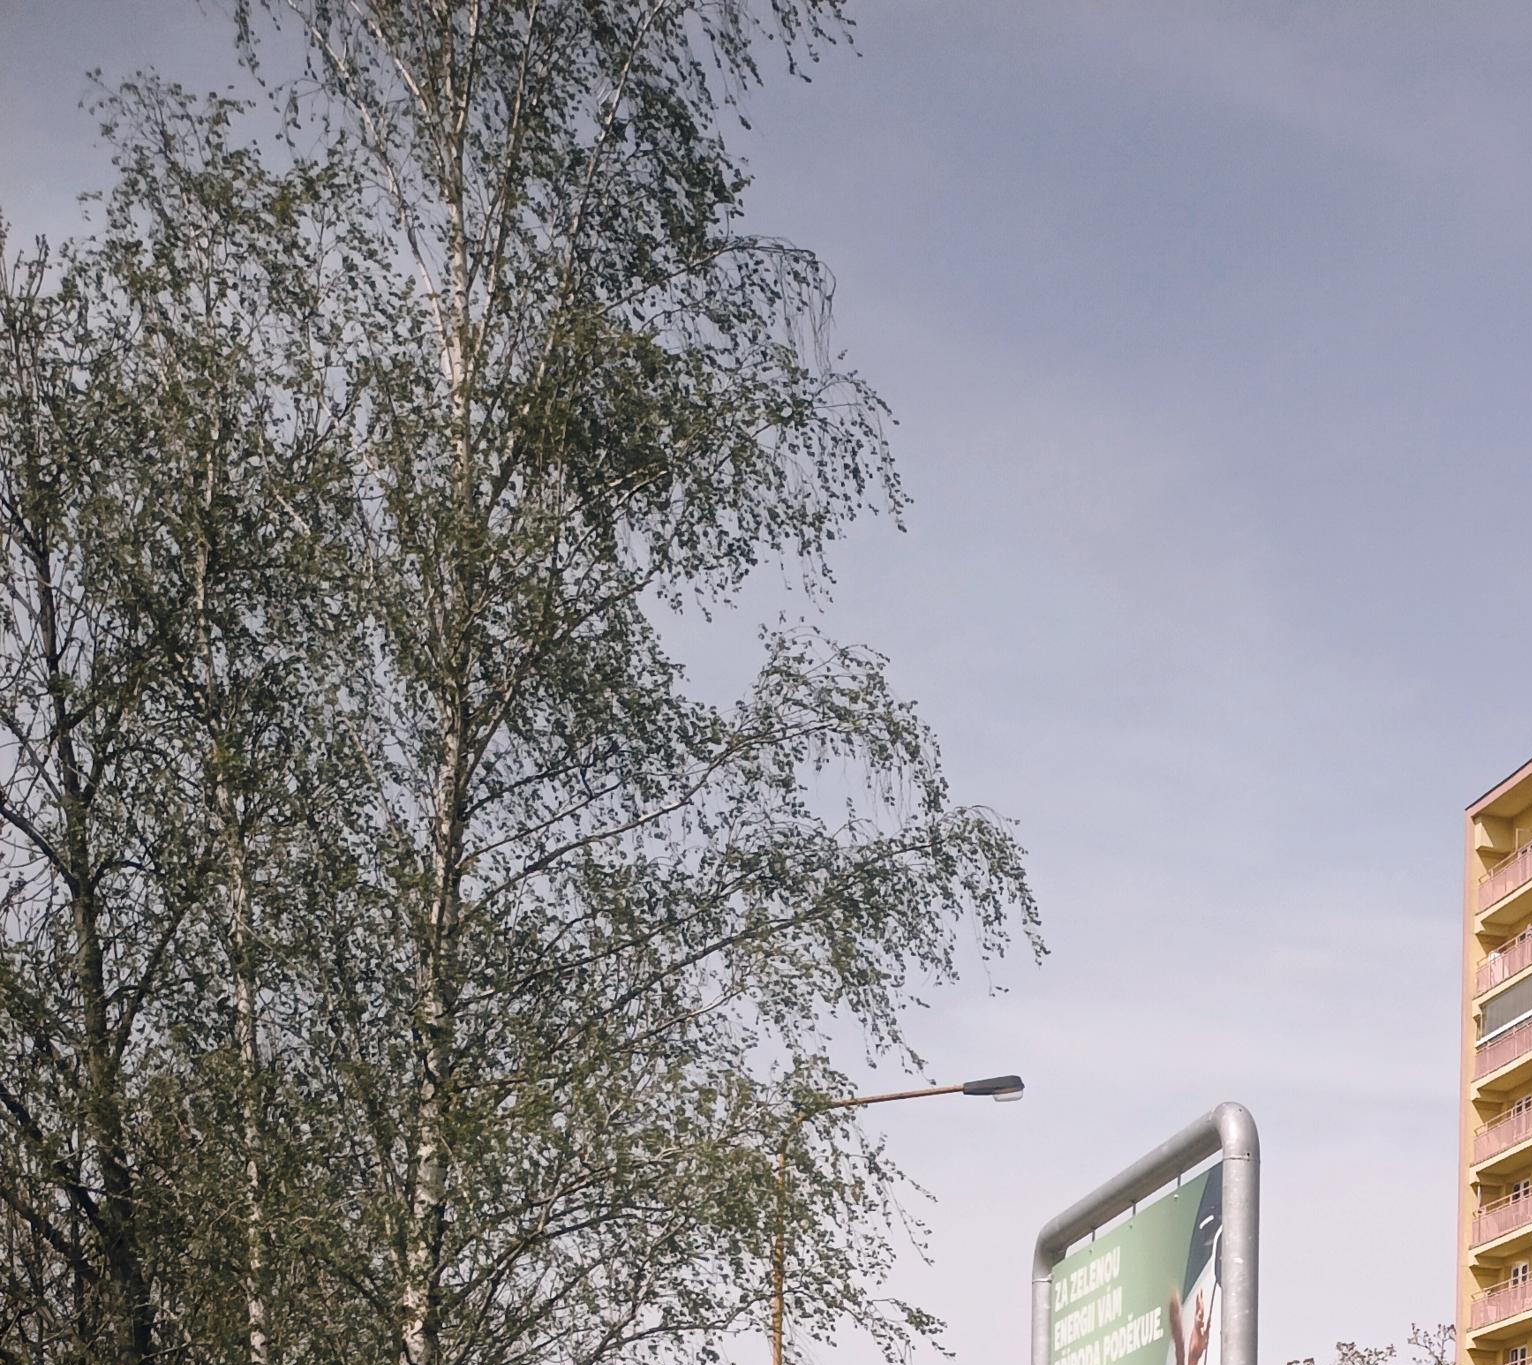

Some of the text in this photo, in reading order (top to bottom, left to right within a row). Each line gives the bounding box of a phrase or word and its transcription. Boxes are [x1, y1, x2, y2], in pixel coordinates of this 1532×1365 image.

[1055, 1246, 1120, 1312] ZA ZELENOU
[1097, 1285, 1122, 1328] VÁM
